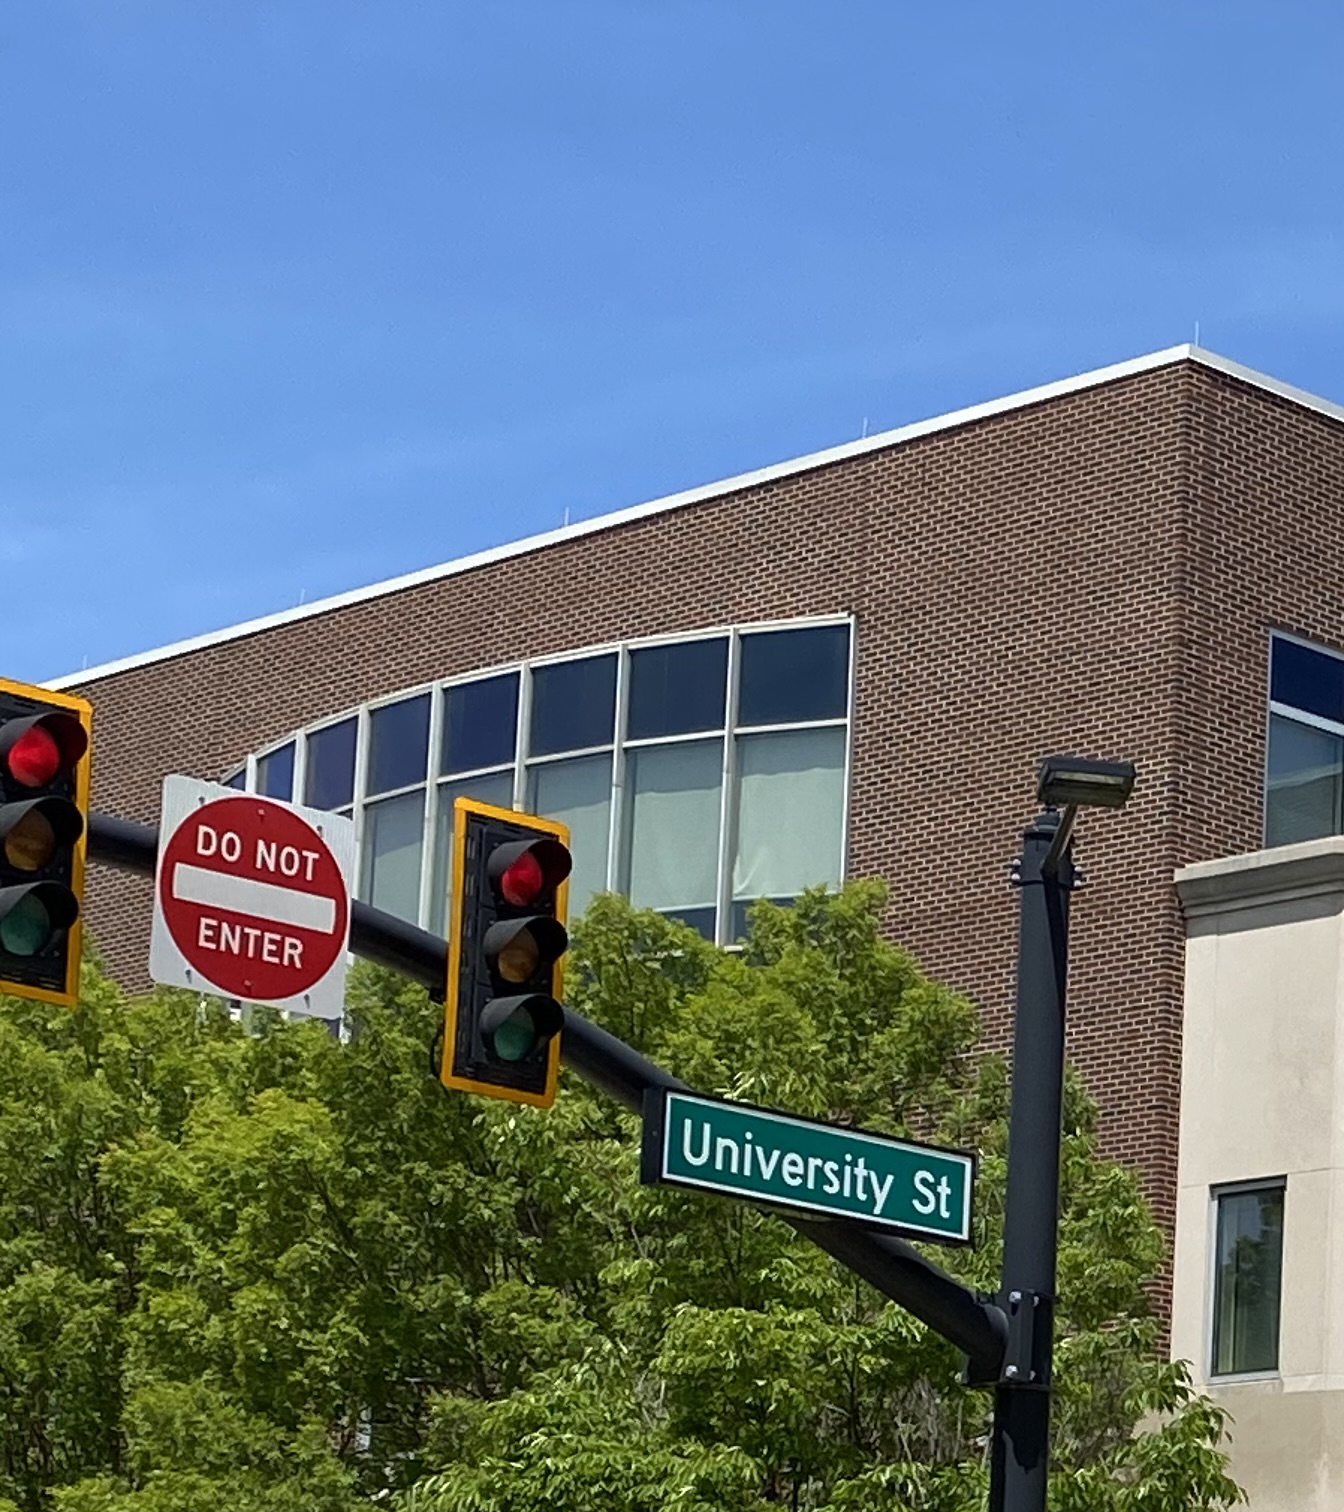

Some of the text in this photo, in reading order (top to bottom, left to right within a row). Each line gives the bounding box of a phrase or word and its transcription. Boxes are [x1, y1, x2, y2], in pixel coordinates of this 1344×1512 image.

[197, 824, 320, 881] DO NOT
[198, 917, 304, 969] ENTER
[682, 1118, 952, 1219] University St
